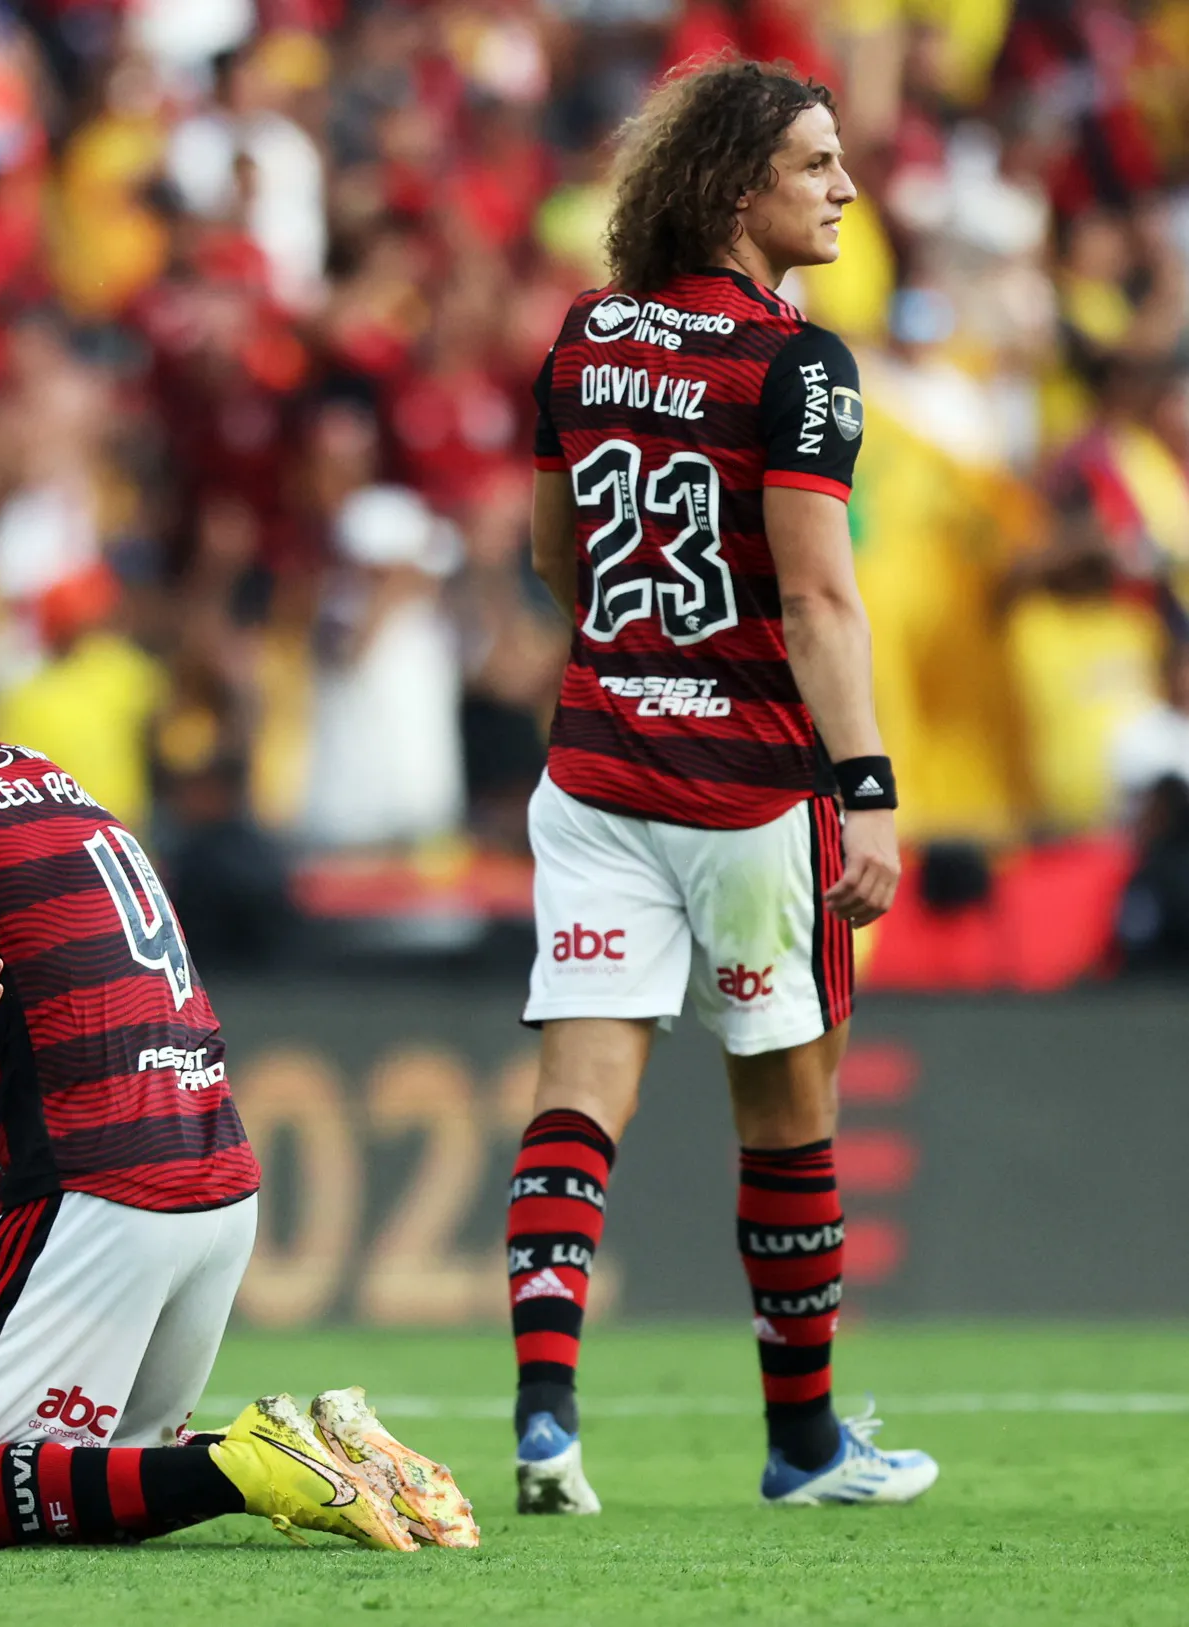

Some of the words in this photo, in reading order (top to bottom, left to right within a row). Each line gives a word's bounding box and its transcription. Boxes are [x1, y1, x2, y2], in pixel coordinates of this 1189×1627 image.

[633, 318, 683, 351] livre
[641, 301, 736, 335] mercado
[581, 364, 650, 409] DAVID
[653, 375, 708, 421] LUIZ
[796, 360, 829, 456] HAVAN
[571, 439, 739, 646] 23
[598, 676, 718, 698] ASSIST
[636, 697, 731, 718] CARD
[82, 825, 194, 1012] 4
[553, 922, 626, 962] abc
[716, 963, 773, 1002] abc
[28, 1418, 42, 1430] da
[36, 1385, 118, 1438] abc
